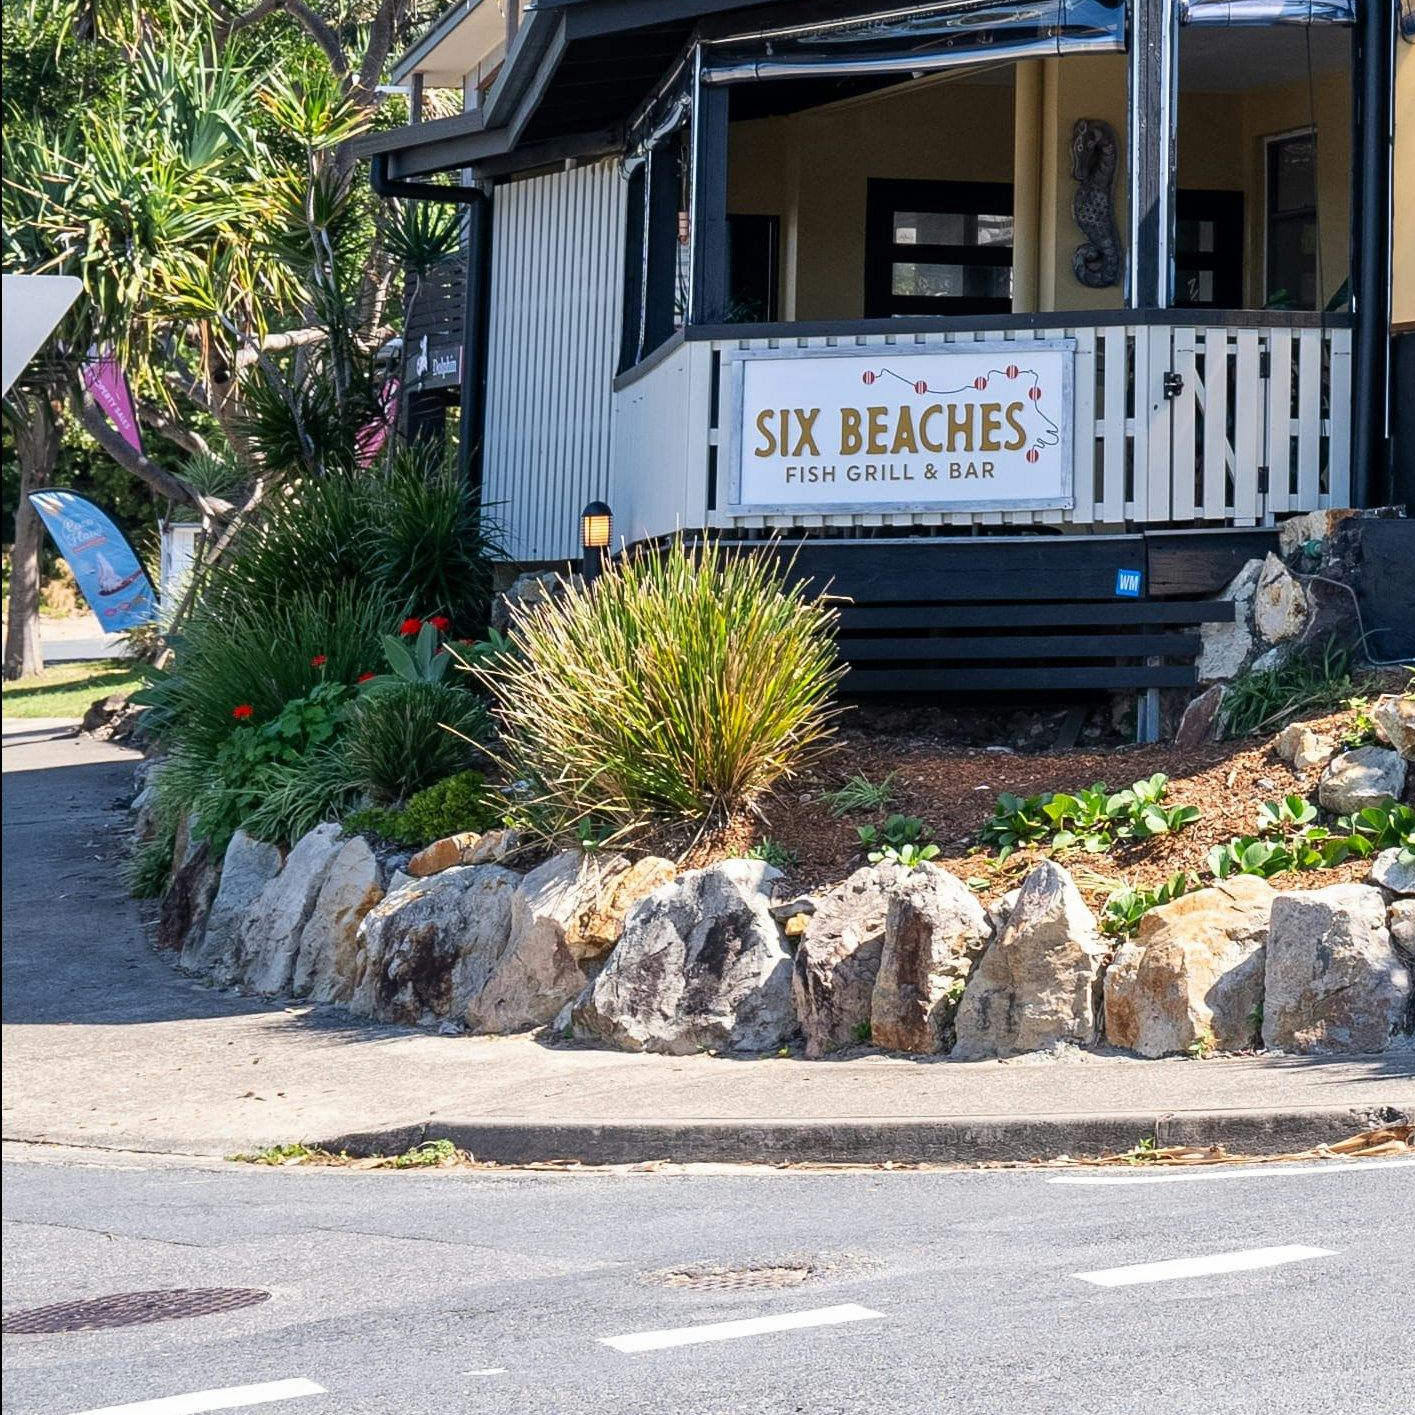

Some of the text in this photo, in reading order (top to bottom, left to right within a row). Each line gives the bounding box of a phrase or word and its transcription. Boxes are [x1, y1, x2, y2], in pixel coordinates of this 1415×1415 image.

[755, 402, 1027, 457] SIX BEACHES
[785, 461, 995, 483] FISH GRILL & BAR
[1119, 574, 1138, 591] WM
